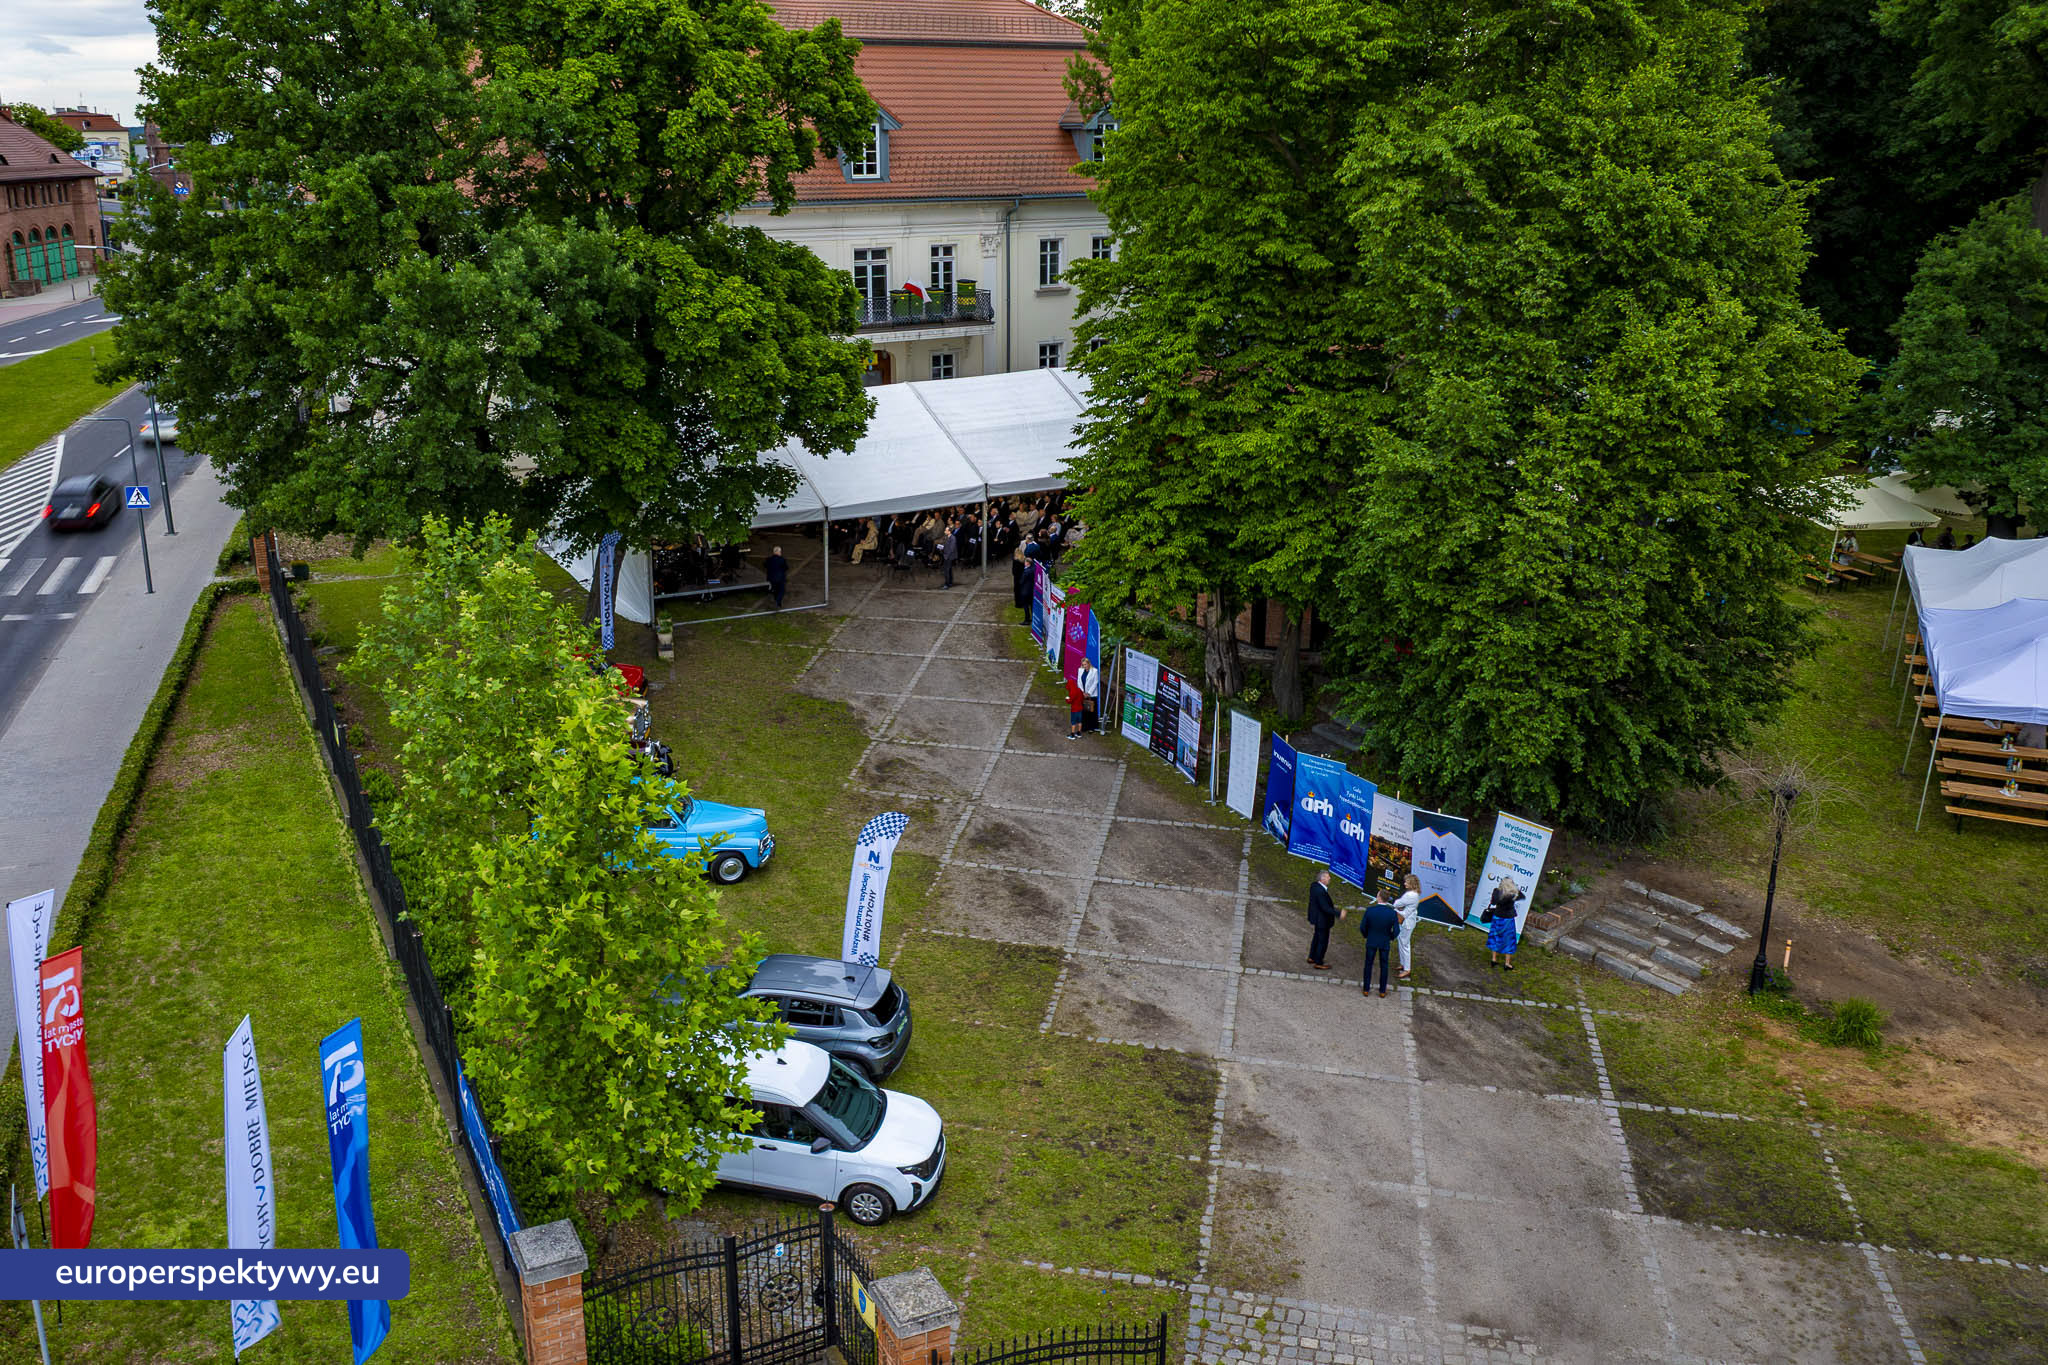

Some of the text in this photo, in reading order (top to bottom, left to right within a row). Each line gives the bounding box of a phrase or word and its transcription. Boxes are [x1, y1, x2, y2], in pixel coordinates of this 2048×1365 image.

[1504, 822, 1543, 840] Wydarzenie
[1499, 835, 1539, 853] patronatem
[1499, 842, 1536, 859] medialnym
[862, 889, 877, 942] #NOLTYCHY
[851, 926, 862, 955] Wszyscy
[44, 1027, 56, 1040] lat
[329, 1106, 340, 1122] lat
[241, 1030, 272, 1249] YCHY DOBRE MIEJSCE
